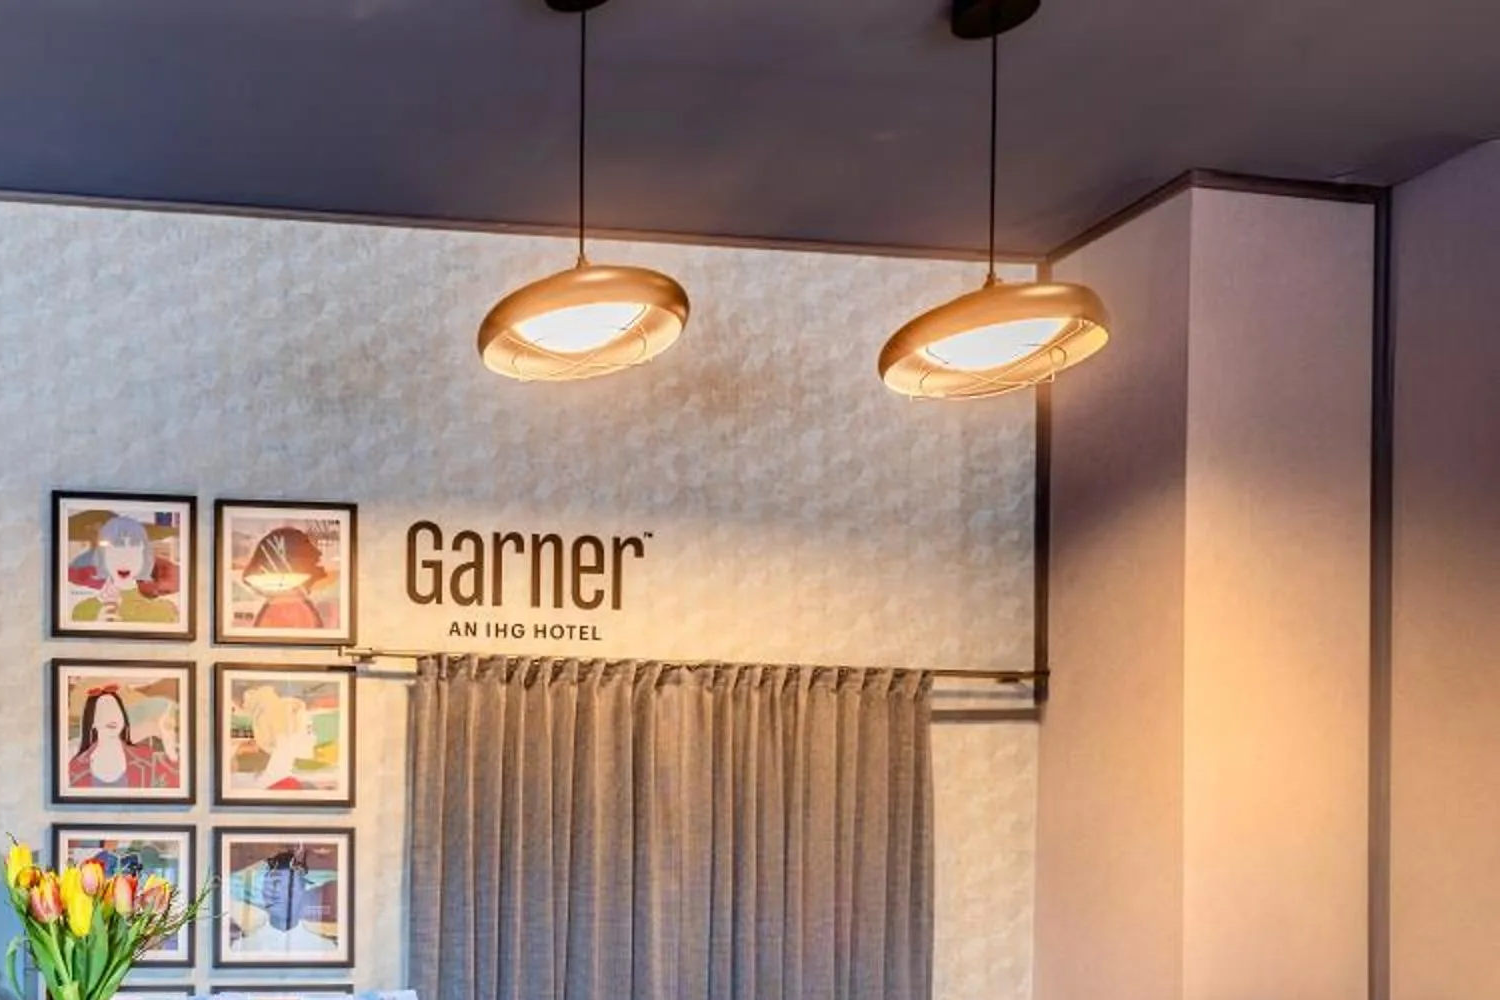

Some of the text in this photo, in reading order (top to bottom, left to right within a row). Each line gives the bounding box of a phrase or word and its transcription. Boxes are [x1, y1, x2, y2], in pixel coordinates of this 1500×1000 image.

[406, 520, 645, 610] Garner
[449, 621, 603, 641] AN IHG HOTEL
